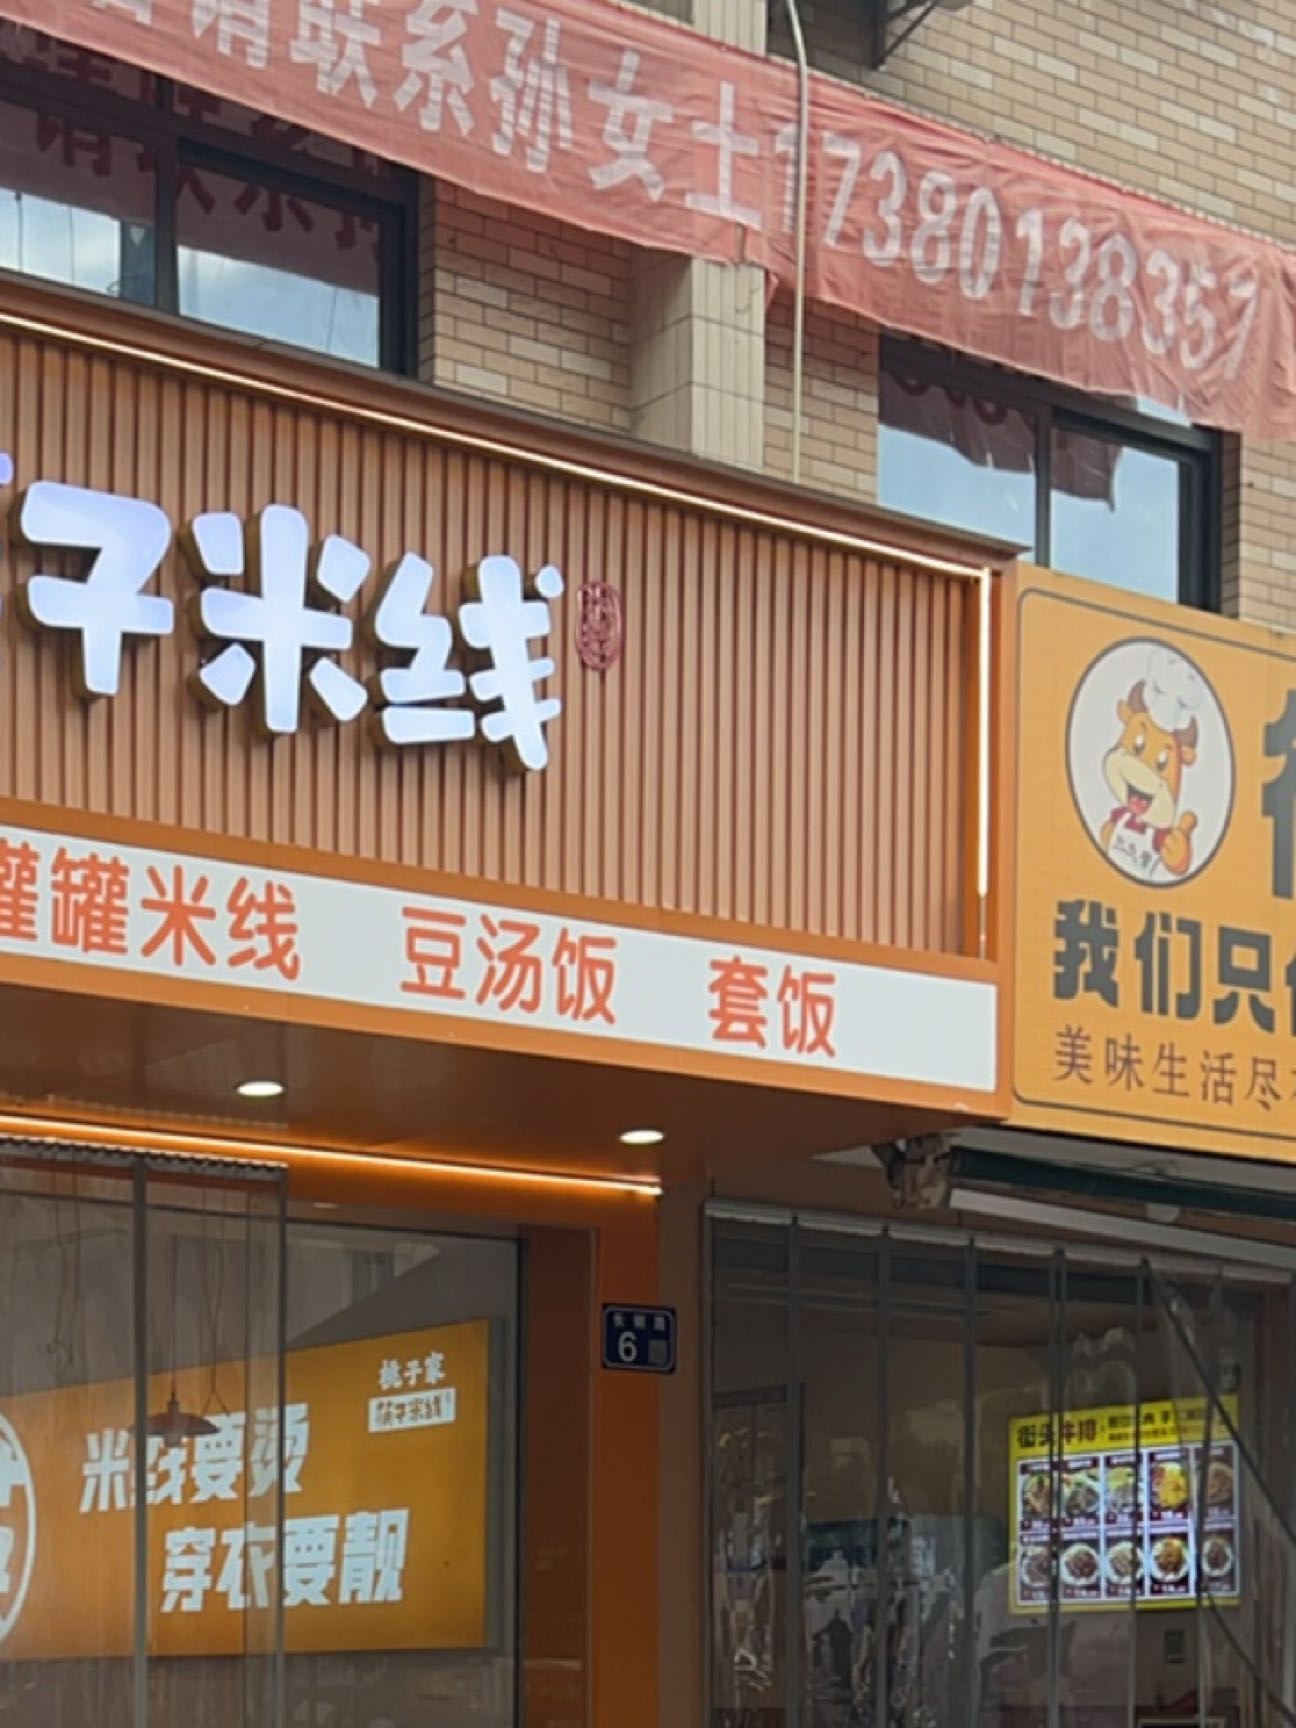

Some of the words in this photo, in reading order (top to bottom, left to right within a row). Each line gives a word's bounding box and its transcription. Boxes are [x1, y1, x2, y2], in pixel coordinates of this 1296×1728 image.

[399, 903, 618, 1026] 豆汤饭
[708, 955, 839, 1058] 套饭
[1053, 898, 1296, 1038] 我们只
[1053, 1022, 1296, 1111] 美味生活尽
[378, 1351, 446, 1390] 桃子家
[160, 1508, 410, 1613] 穿衣要靓
